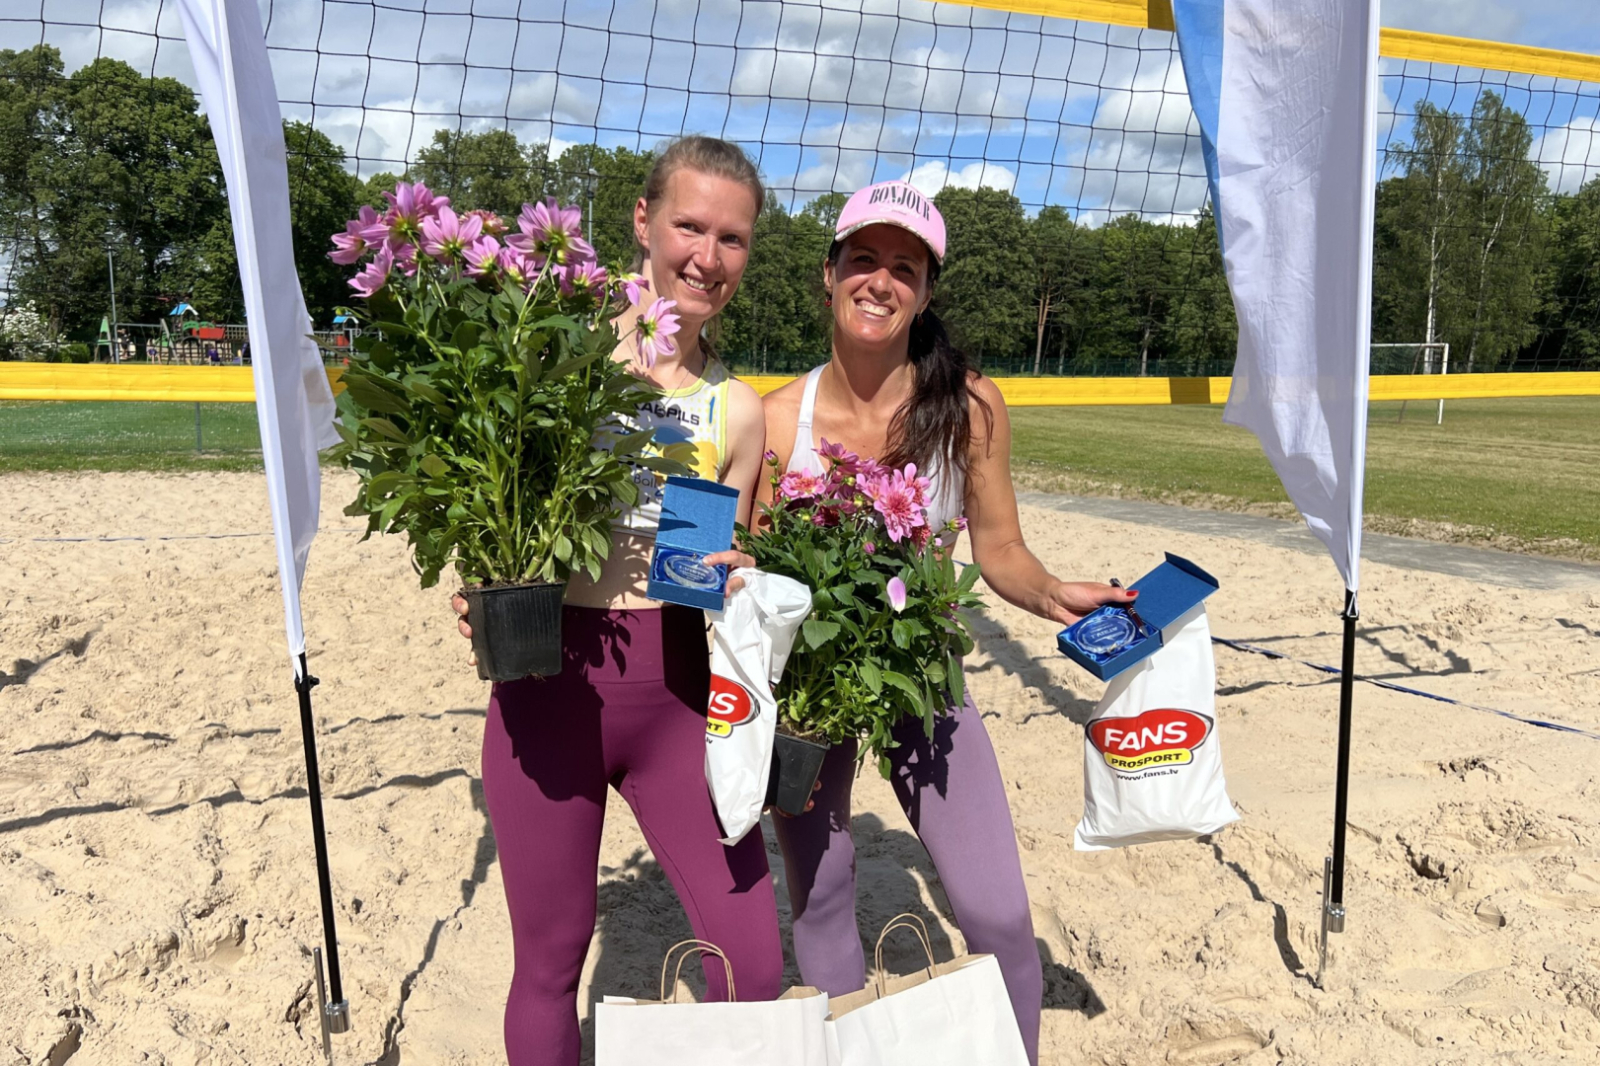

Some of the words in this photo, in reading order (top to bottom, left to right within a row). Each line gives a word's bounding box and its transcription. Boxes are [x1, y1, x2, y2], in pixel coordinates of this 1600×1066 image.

[869, 185, 930, 221] BONJOUR
[1104, 721, 1188, 751] FANS
[1111, 752, 1183, 768] PROSPORT
[1115, 768, 1179, 781] www.fans.lv
